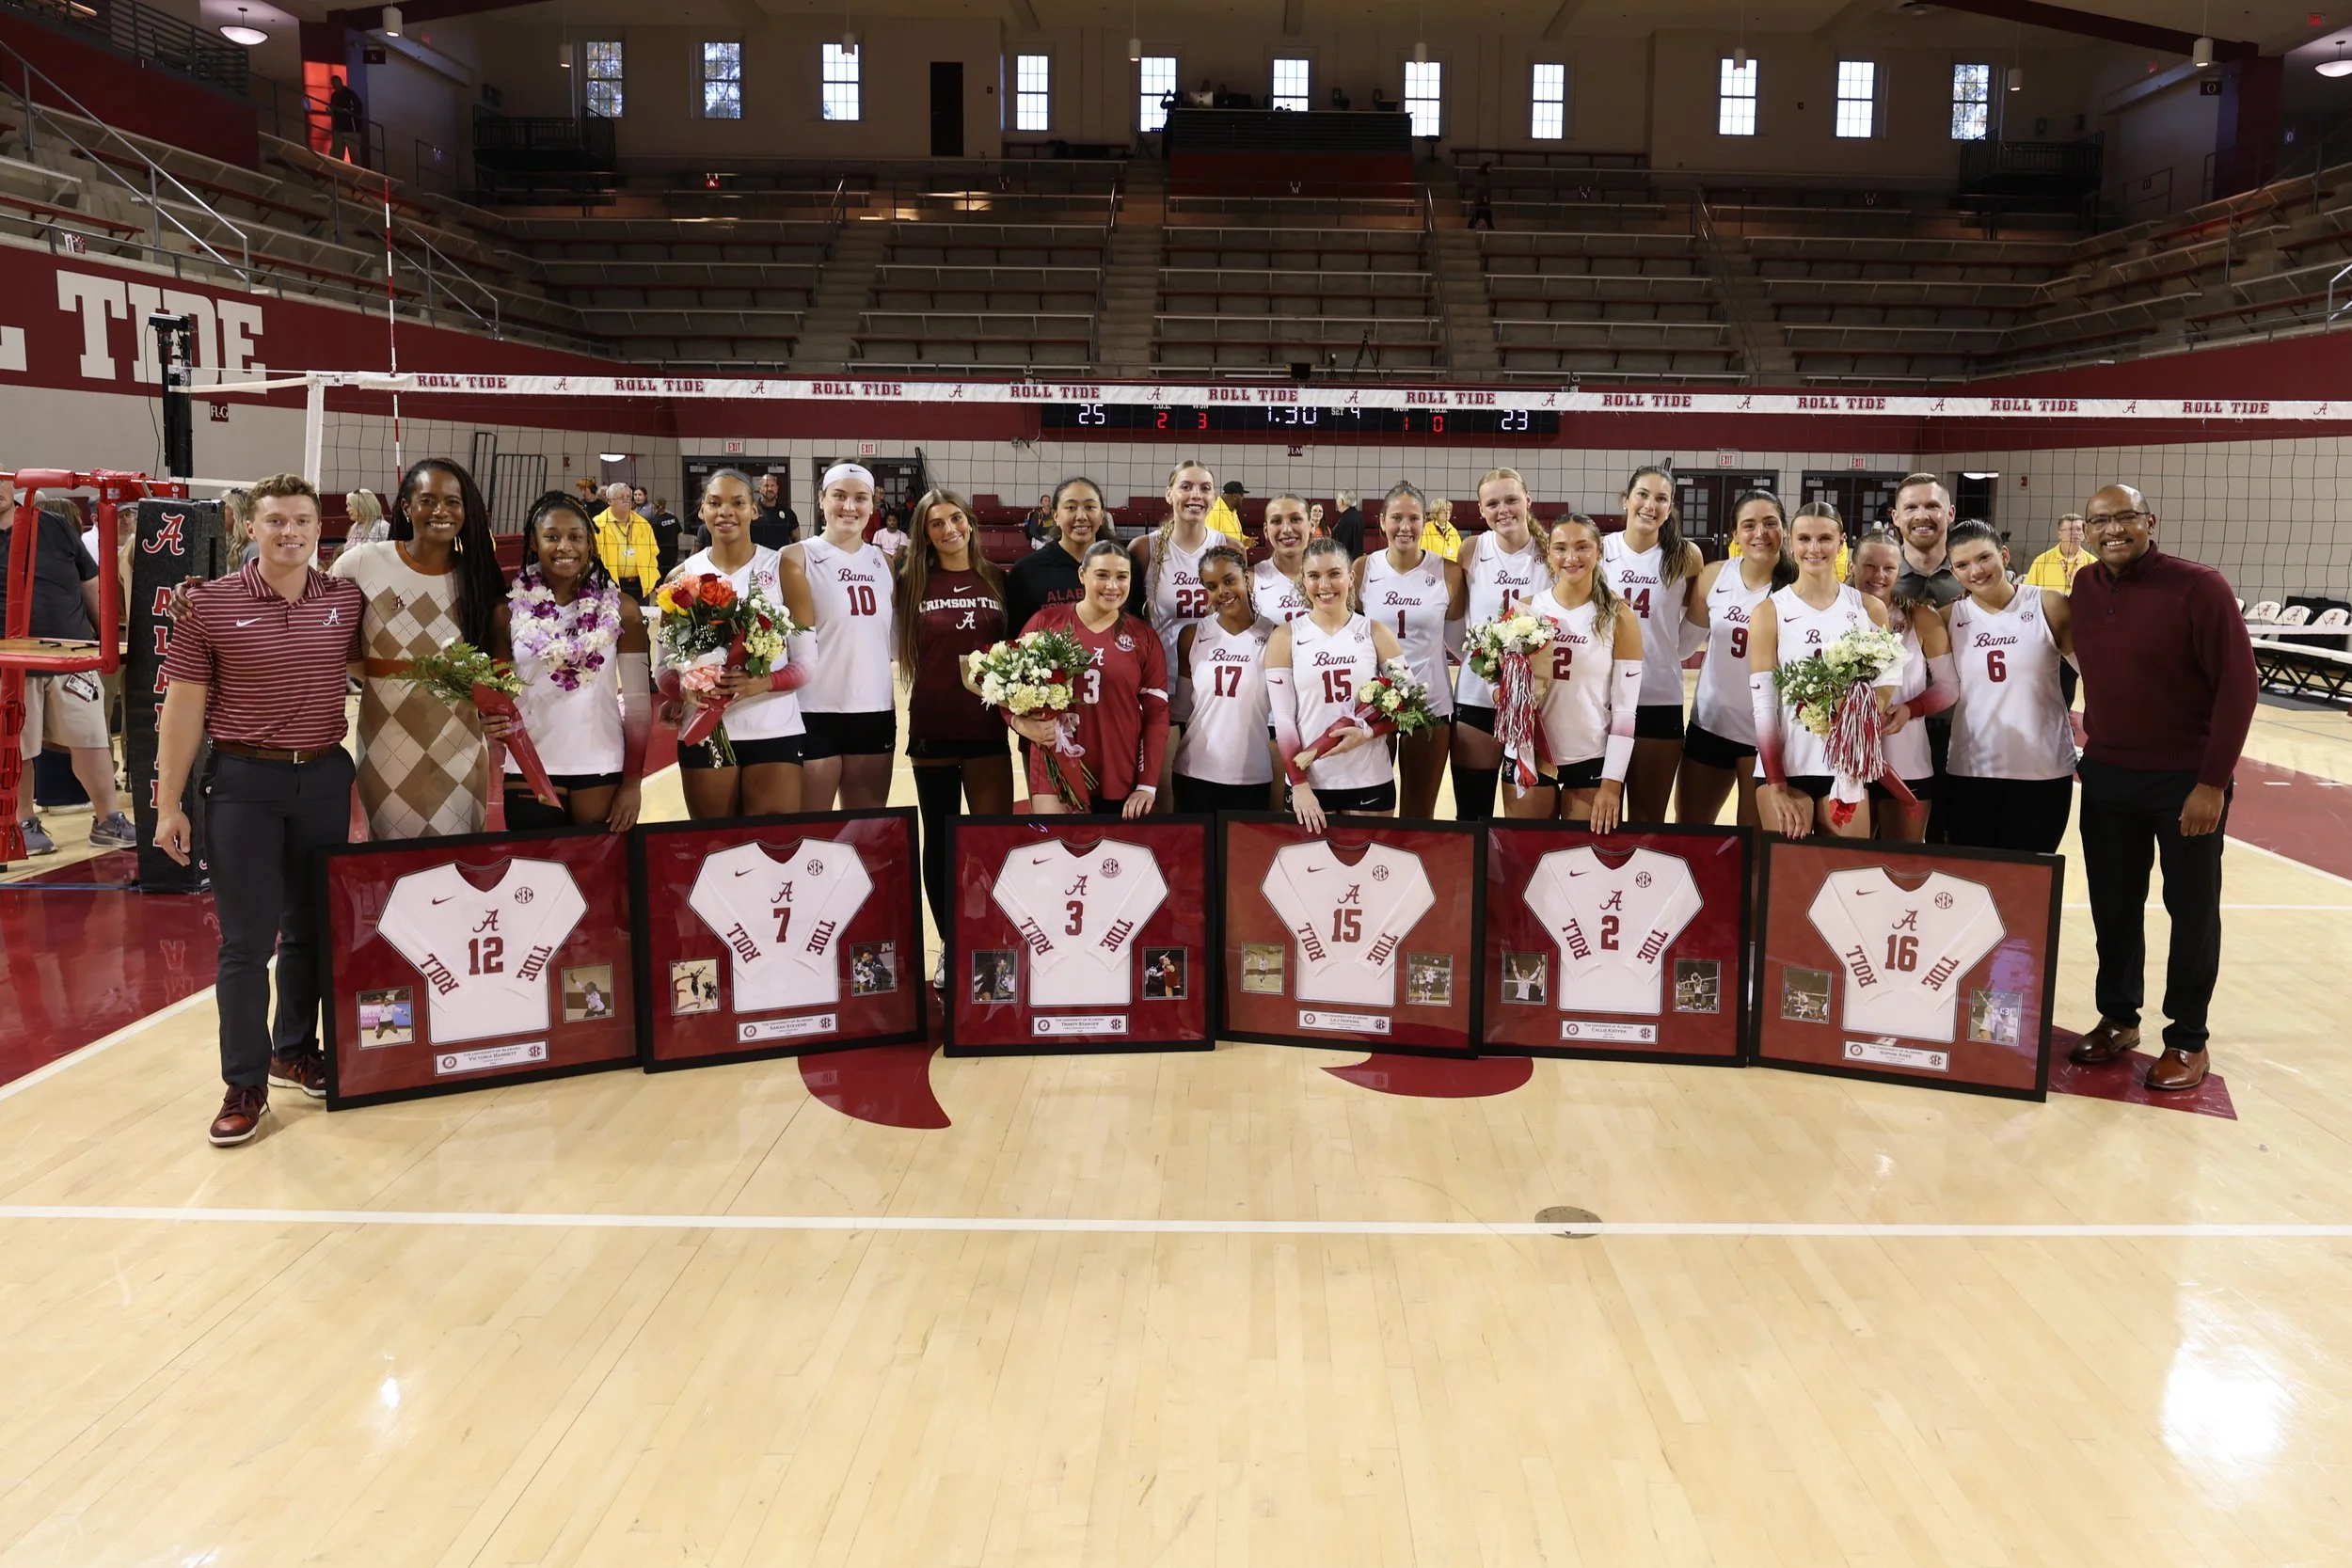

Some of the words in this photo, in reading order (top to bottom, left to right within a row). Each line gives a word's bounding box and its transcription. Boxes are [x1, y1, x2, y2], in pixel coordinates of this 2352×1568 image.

[2206, 83, 2217, 94] O
[56, 269, 267, 394] TIDE
[417, 375, 461, 389] ROLL
[467, 376, 506, 389] TIDE
[615, 380, 658, 392] ROLL
[664, 381, 704, 392] TIDE
[812, 383, 854, 395] ROLL
[863, 384, 901, 397] TIDE
[1009, 387, 1053, 399] ROLL
[1060, 388, 1100, 400] TIDE
[1209, 389, 1250, 403] ROLL
[1259, 390, 1296, 403] TIDE
[1406, 392, 1446, 405] ROLL
[1456, 393, 1496, 405] TIDE
[1603, 395, 1645, 407] ROLL
[1652, 396, 1692, 408] TIDE
[1078, 404, 1105, 424] 25
[1797, 398, 1839, 410] ROLL
[1848, 399, 1885, 410] TIDE
[1992, 401, 2032, 413] ROLL
[2042, 401, 2077, 413] TIDE
[2182, 402, 2223, 415] ROLL
[2232, 403, 2270, 416] TIDE
[1157, 412, 1168, 429] 2
[1198, 412, 1207, 429] 3
[1433, 416, 1443, 433] 0
[1502, 409, 1529, 431] 23
[728, 442, 740, 452] EXIT
[861, 443, 874, 453] EXIT
[1720, 455, 1733, 466] EXIT
[1851, 457, 1864, 468] EXIT
[837, 568, 876, 584] Bama
[1171, 571, 1204, 586] Bam
[1494, 570, 1531, 586] Bama
[1618, 569, 1659, 585] Bama
[847, 585, 877, 616] 10
[1176, 589, 1209, 619] 22
[1383, 591, 1422, 607] Bama
[1623, 588, 1651, 619] 14
[955, 610, 976, 630] A
[1397, 610, 1406, 640] 1
[1731, 627, 1749, 659] 9
[1973, 632, 2018, 649] Bama
[1208, 648, 1251, 663] Bama
[1311, 651, 1358, 667] Bama
[1553, 647, 1573, 681] 2
[1987, 649, 2007, 683] 6
[1083, 669, 1101, 705] 3
[1214, 665, 1243, 698] 17
[1321, 669, 1352, 704] 15
[807, 859, 823, 877] SEC
[1102, 858, 1119, 874] SEC
[1372, 864, 1389, 881] SEC
[1065, 875, 1088, 895] A
[1635, 871, 1652, 888] SEC
[515, 887, 533, 904] SEC
[771, 880, 793, 903] A
[1337, 884, 1360, 904] A
[1599, 890, 1623, 911] A
[1934, 892, 1953, 910] SEC
[472, 909, 500, 933] A
[772, 907, 791, 943] 7
[1065, 900, 1083, 936] 3
[1331, 908, 1362, 942] 15
[1892, 909, 1917, 931] A
[806, 920, 836, 956] TIDE
[1020, 916, 1054, 957] ROLL
[1099, 918, 1134, 953] TIDE
[1297, 922, 1327, 963] ROLL
[1562, 918, 1592, 960] ROLL
[1600, 914, 1619, 951] 2
[726, 922, 762, 964] ROLL
[1366, 932, 1399, 966] TIDE
[1636, 929, 1668, 965] TIDE
[469, 936, 504, 975] 12
[516, 944, 553, 982] TIDE
[1884, 934, 1919, 973] 16
[420, 952, 460, 996] ROLL
[1846, 944, 1878, 990] ROLL
[1921, 956, 1959, 991] TIDE
